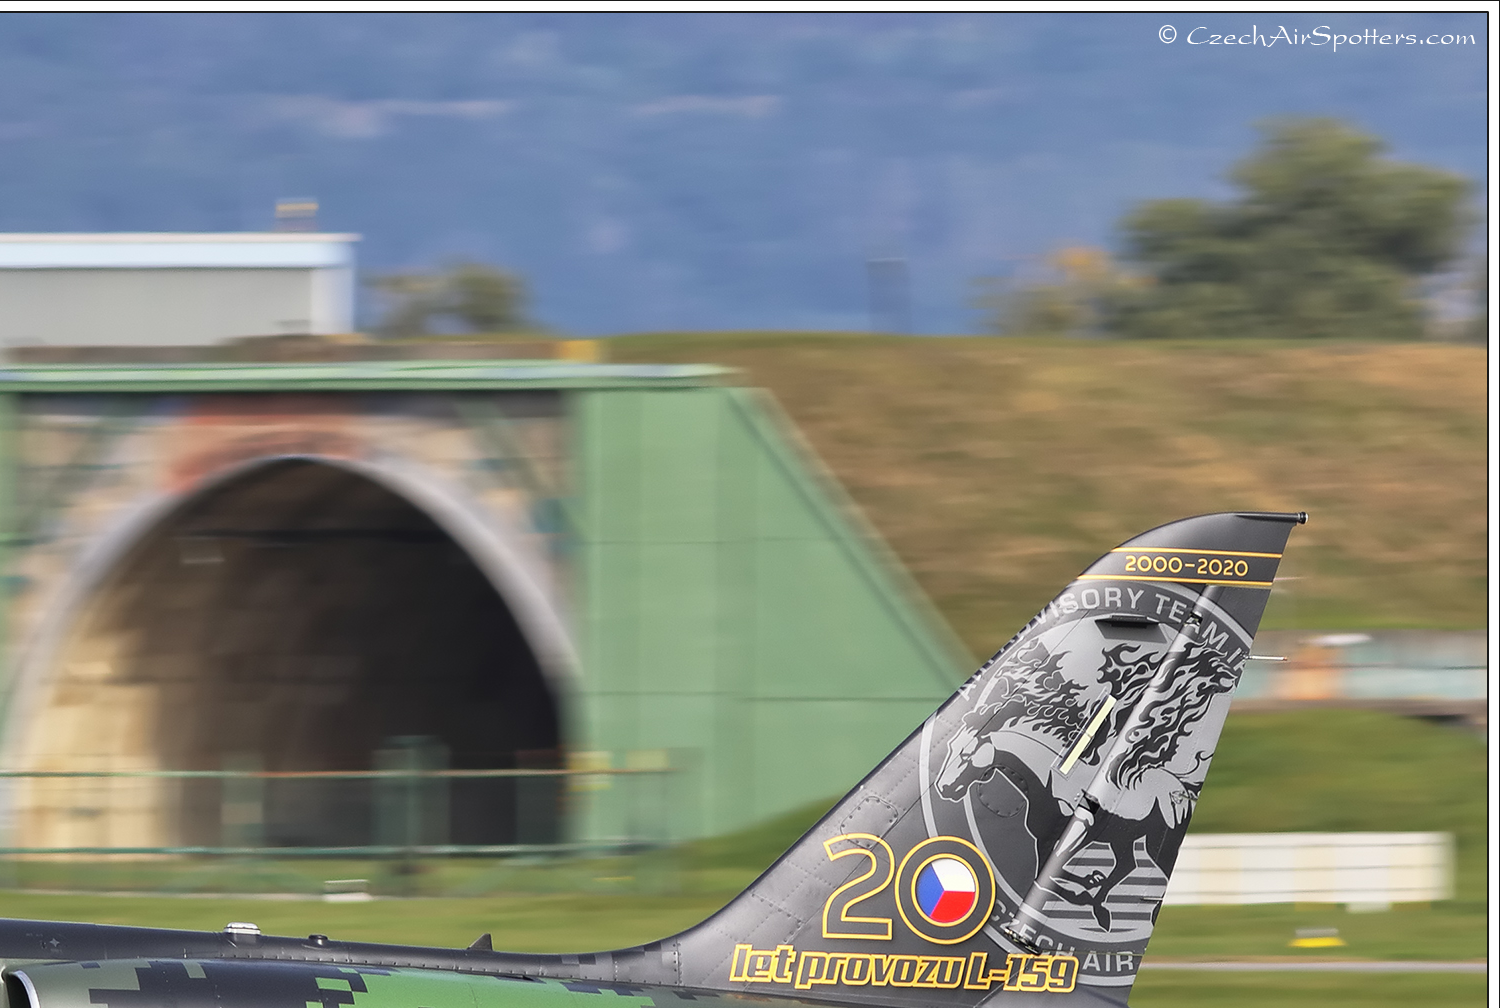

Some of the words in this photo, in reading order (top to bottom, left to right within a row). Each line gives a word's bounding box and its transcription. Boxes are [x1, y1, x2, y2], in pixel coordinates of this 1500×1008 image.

[1125, 555, 1249, 577] 2000-2020
[822, 832, 996, 945] 20
[730, 944, 797, 983] let
[795, 952, 966, 990] provozu
[964, 951, 1080, 993] L-159
[1082, 950, 1134, 972] AIR
